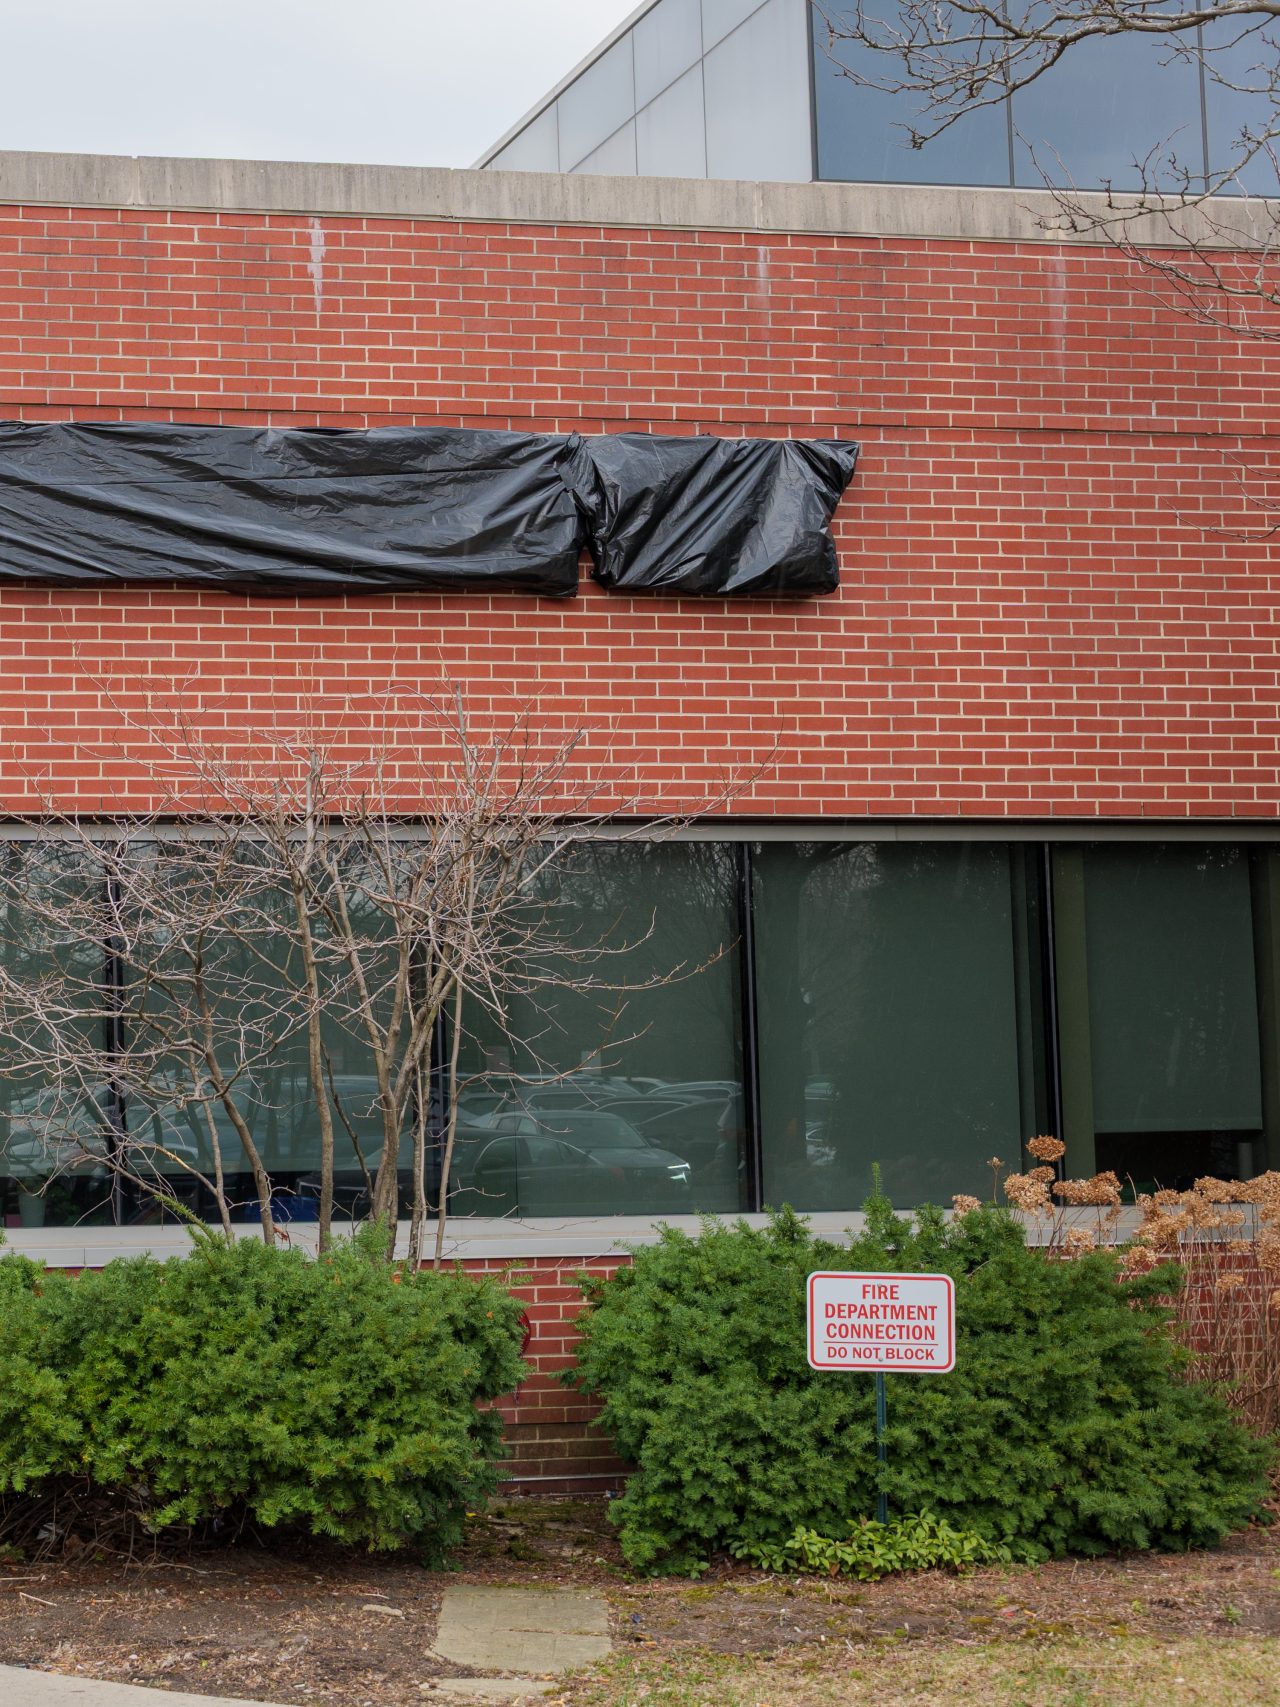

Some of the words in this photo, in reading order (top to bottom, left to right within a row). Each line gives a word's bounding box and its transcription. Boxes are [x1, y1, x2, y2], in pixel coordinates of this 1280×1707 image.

[862, 1284, 900, 1300] FIRE
[824, 1303, 938, 1320] DEPARTMENT
[826, 1323, 935, 1340] CONNECTION
[827, 1346, 848, 1358] DO
[852, 1346, 881, 1359] NOT
[885, 1347, 935, 1361] BLOCK
